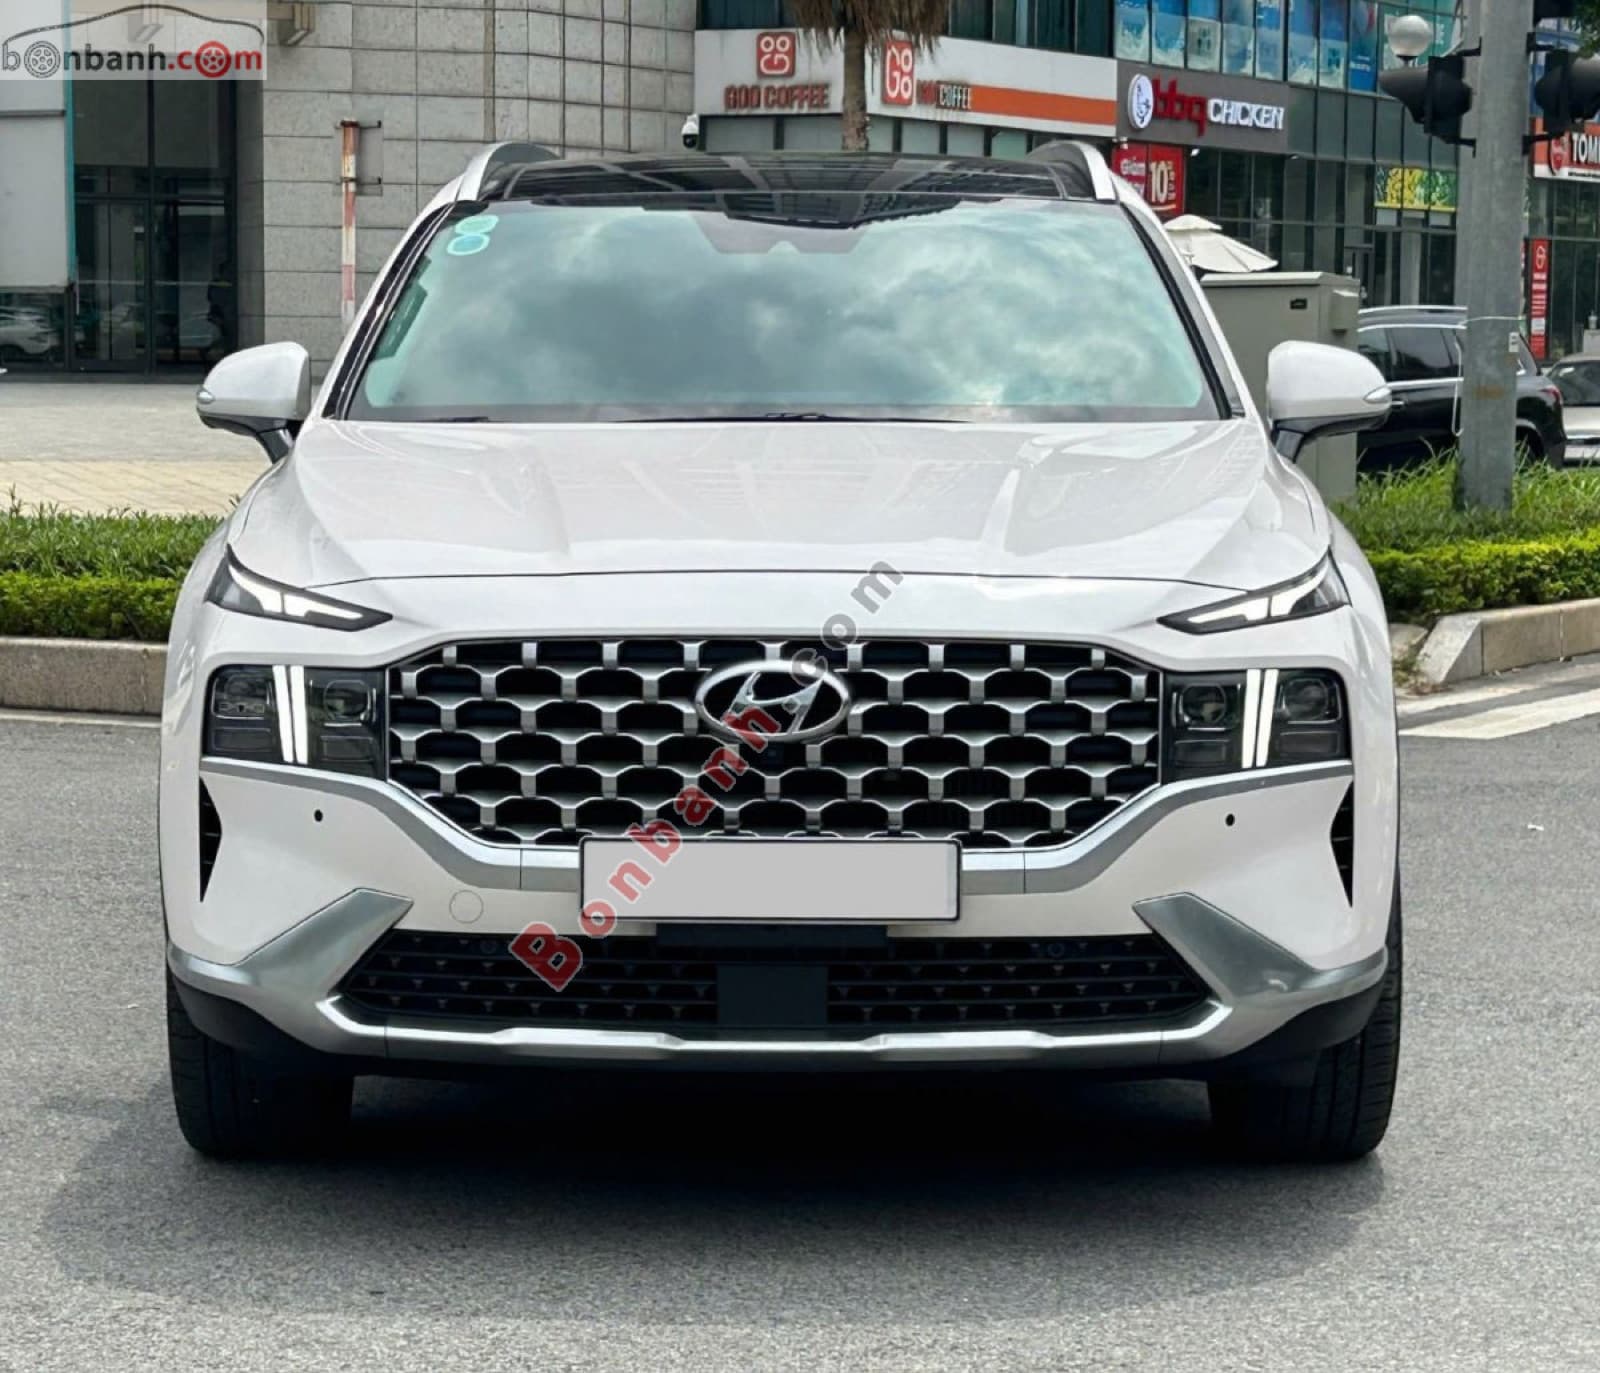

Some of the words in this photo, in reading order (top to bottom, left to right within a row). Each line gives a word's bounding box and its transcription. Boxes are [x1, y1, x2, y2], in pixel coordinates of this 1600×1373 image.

[1153, 77, 1208, 138] bbq
[1208, 98, 1285, 130] CHICKEN
[1572, 132, 1600, 164] TOM
[1150, 160, 1168, 203] 10
